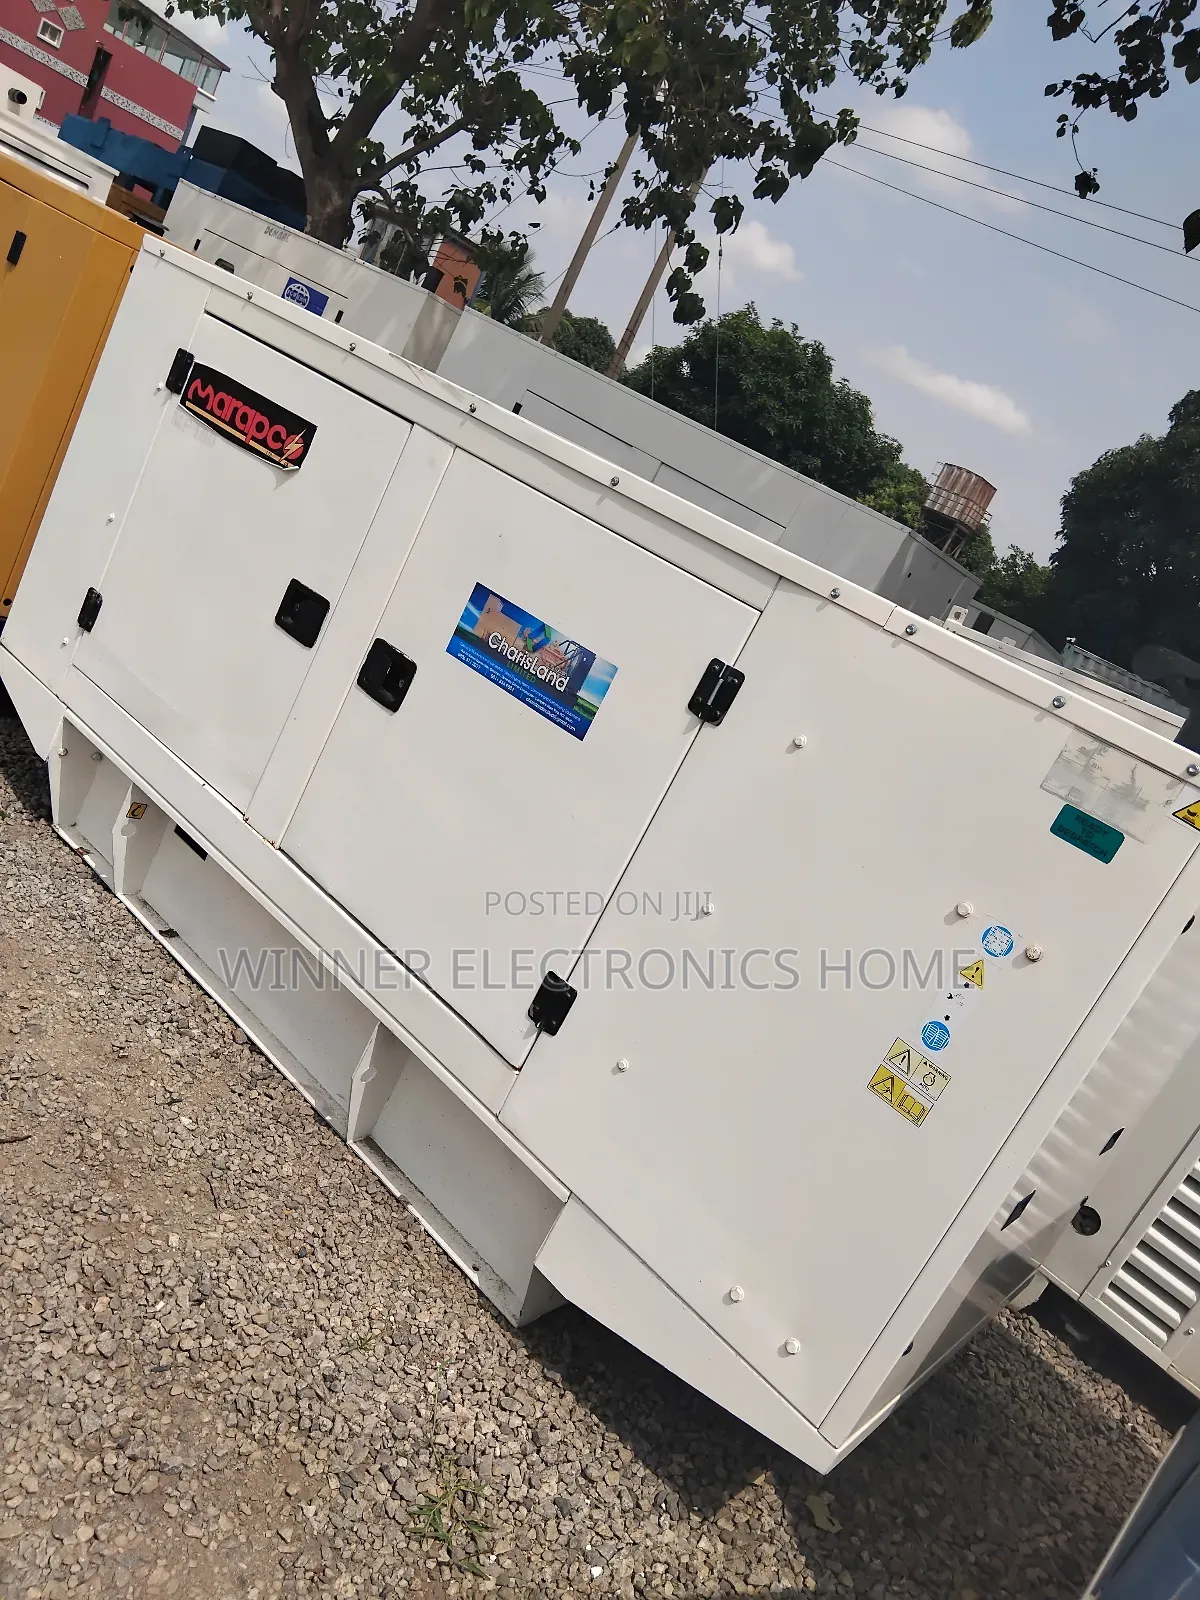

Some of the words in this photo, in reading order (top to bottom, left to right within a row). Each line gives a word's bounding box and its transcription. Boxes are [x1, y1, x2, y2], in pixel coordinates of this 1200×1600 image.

[507, 663, 536, 683] LIMITED
[1076, 815, 1108, 836] READY
[929, 1064, 949, 1080] WARNING
